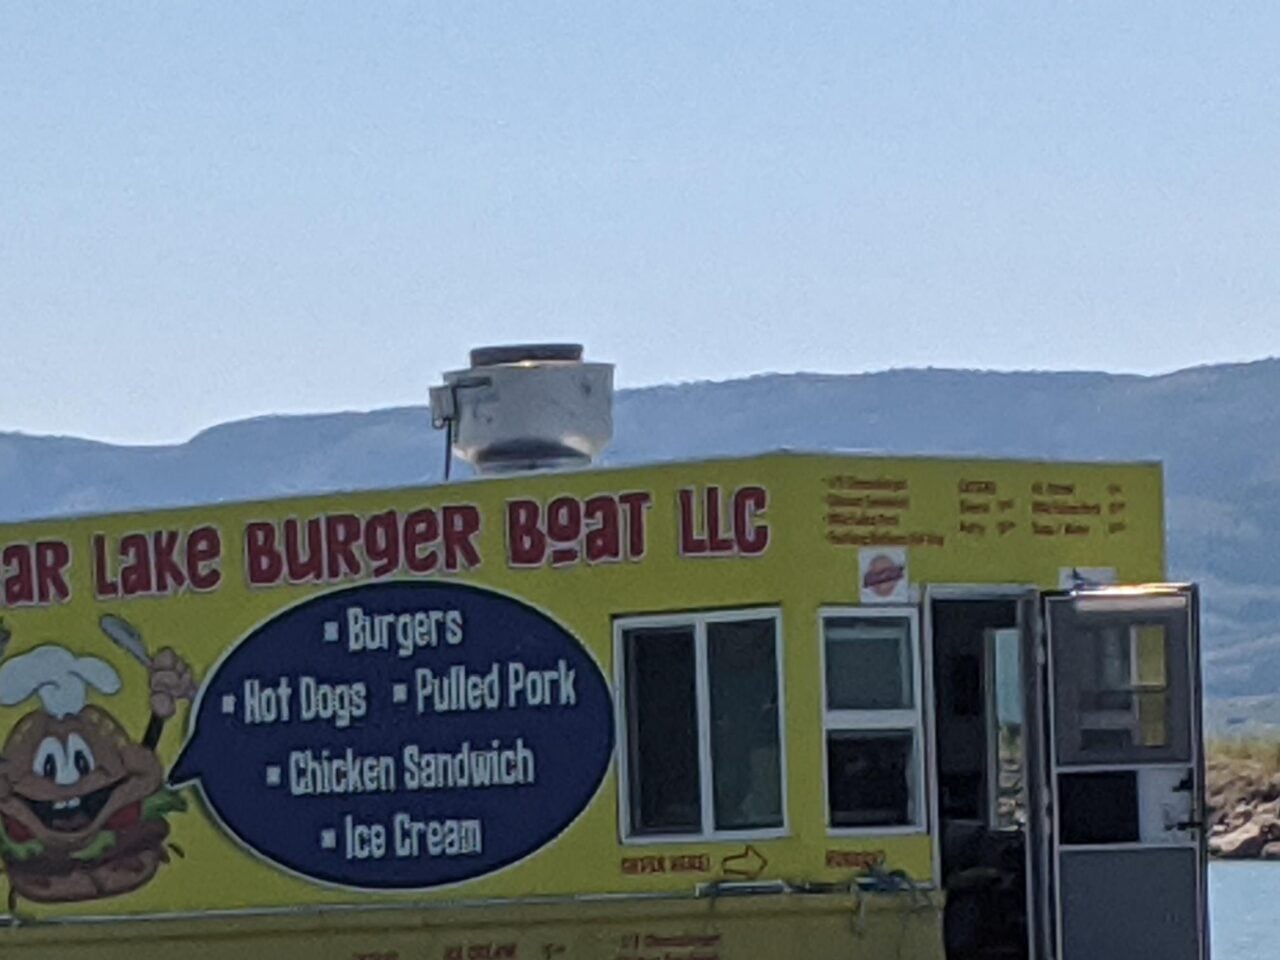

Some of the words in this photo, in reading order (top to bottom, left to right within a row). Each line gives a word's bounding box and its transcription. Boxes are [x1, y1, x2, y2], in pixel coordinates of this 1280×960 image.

[678, 485, 770, 556] LLC
[347, 606, 463, 656] Burgers
[243, 678, 292, 724] Hot
[300, 679, 367, 729] Dogs
[415, 664, 500, 714] Pulled
[508, 659, 578, 707] Pork
[288, 750, 396, 795] Chicken
[403, 738, 535, 790] Sandwich
[344, 815, 386, 859] Ice
[394, 812, 483, 856] Cream
